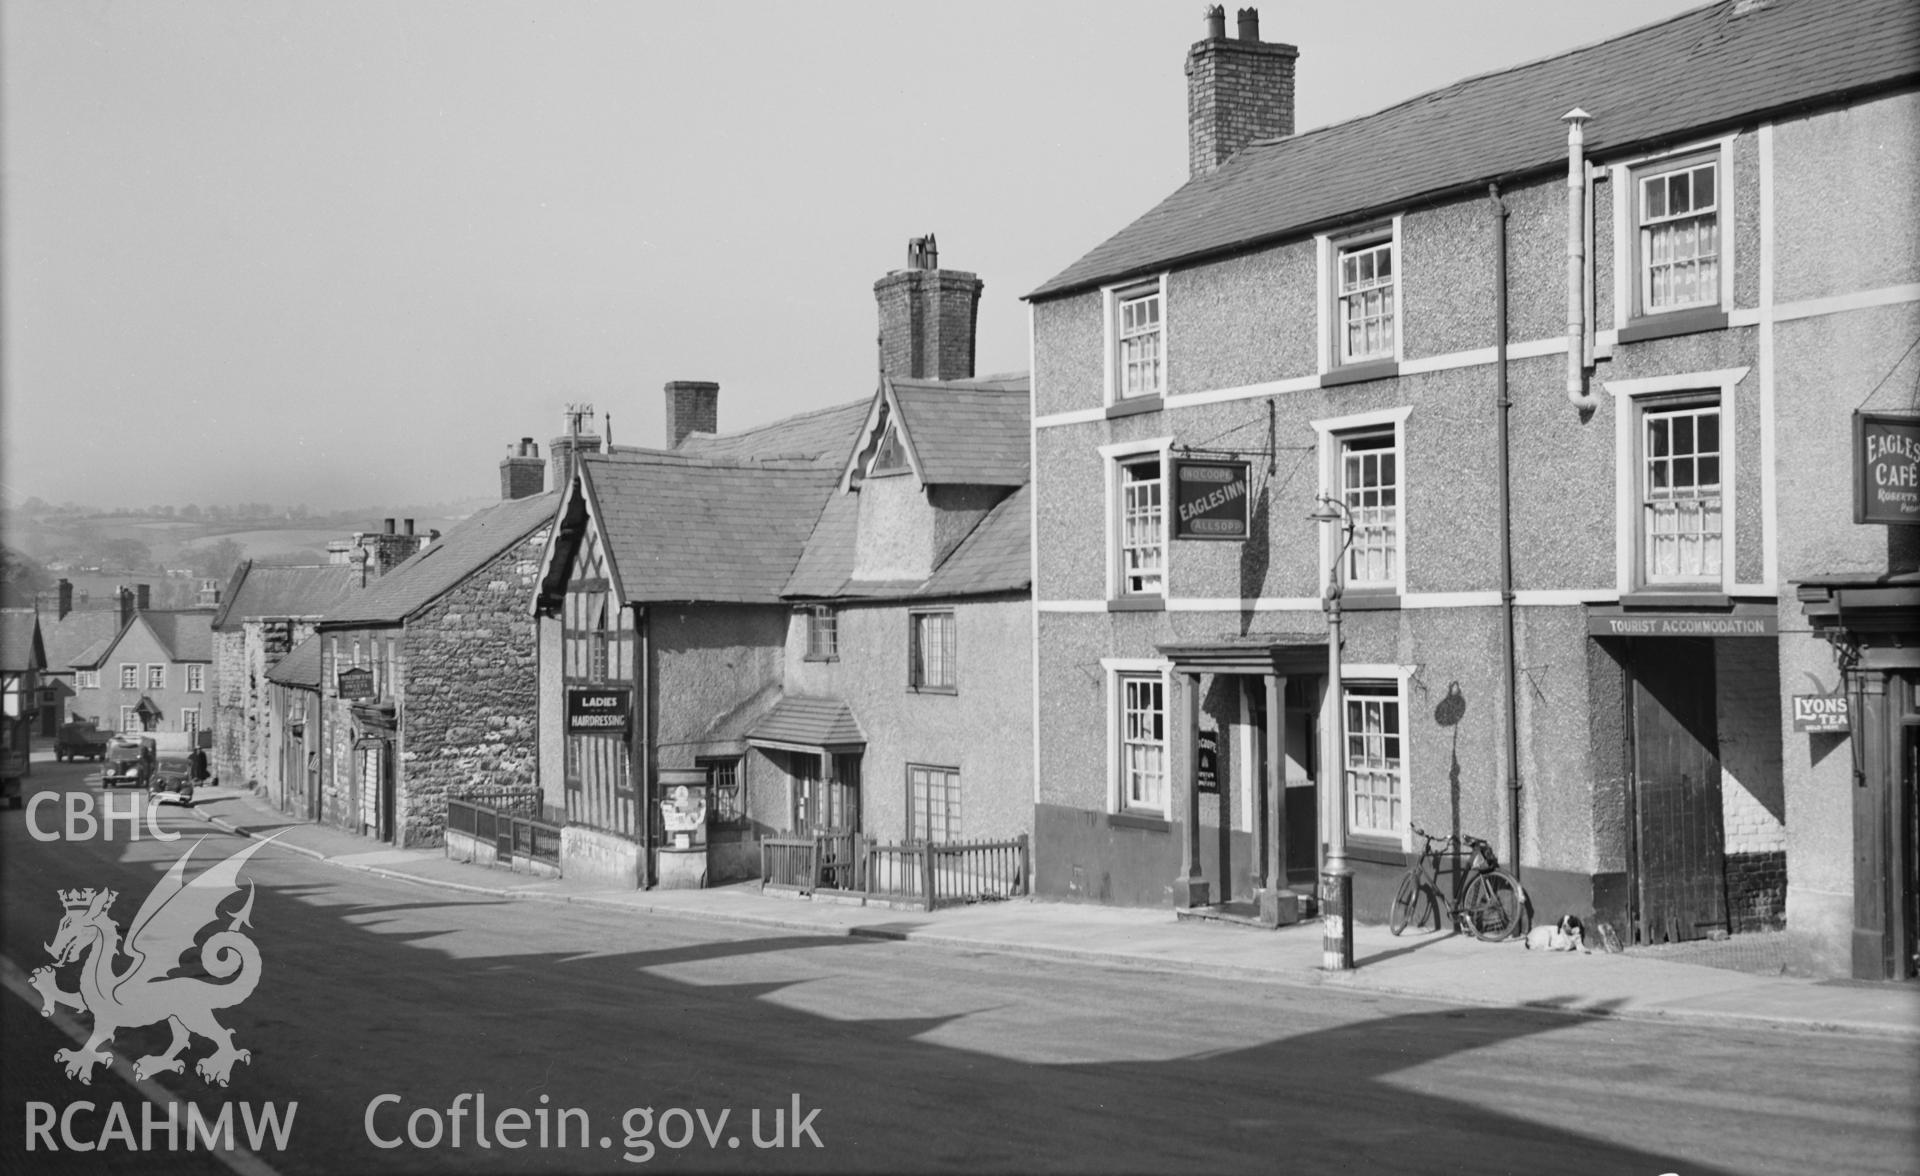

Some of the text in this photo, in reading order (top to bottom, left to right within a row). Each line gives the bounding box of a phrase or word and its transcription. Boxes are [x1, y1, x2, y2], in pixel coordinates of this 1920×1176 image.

[1867, 433, 1920, 464] EAGLES
[1179, 479, 1245, 521] EAGLES INN
[1609, 620, 1765, 633] TOURIST ACCOMMODATION
[582, 697, 617, 707] LADIES
[1794, 696, 1848, 721] LYONS
[571, 715, 625, 727] HAIRDRESSING
[1818, 714, 1848, 725] TEA
